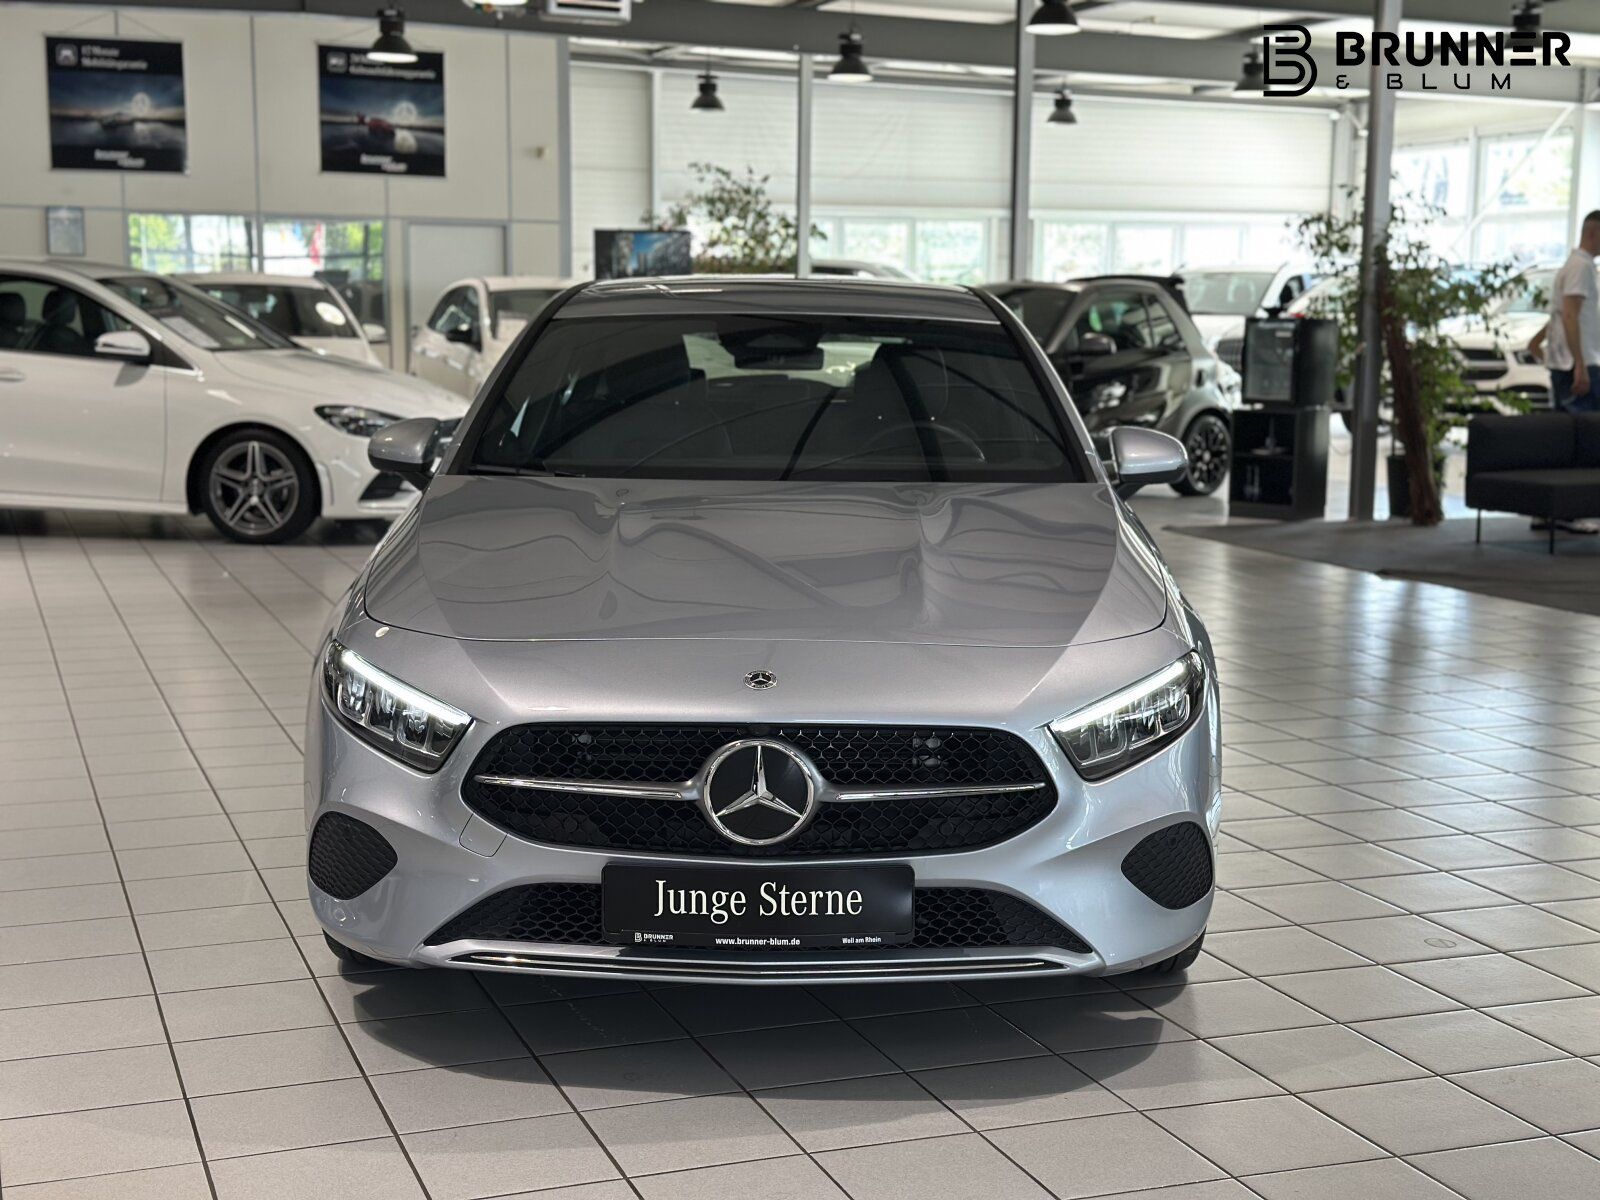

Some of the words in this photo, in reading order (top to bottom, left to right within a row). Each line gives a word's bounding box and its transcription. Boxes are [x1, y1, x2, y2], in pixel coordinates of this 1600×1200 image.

[653, 879, 747, 925] Junge
[759, 881, 863, 916] Sterne
[715, 937, 801, 946] www.brunner-blum.de
